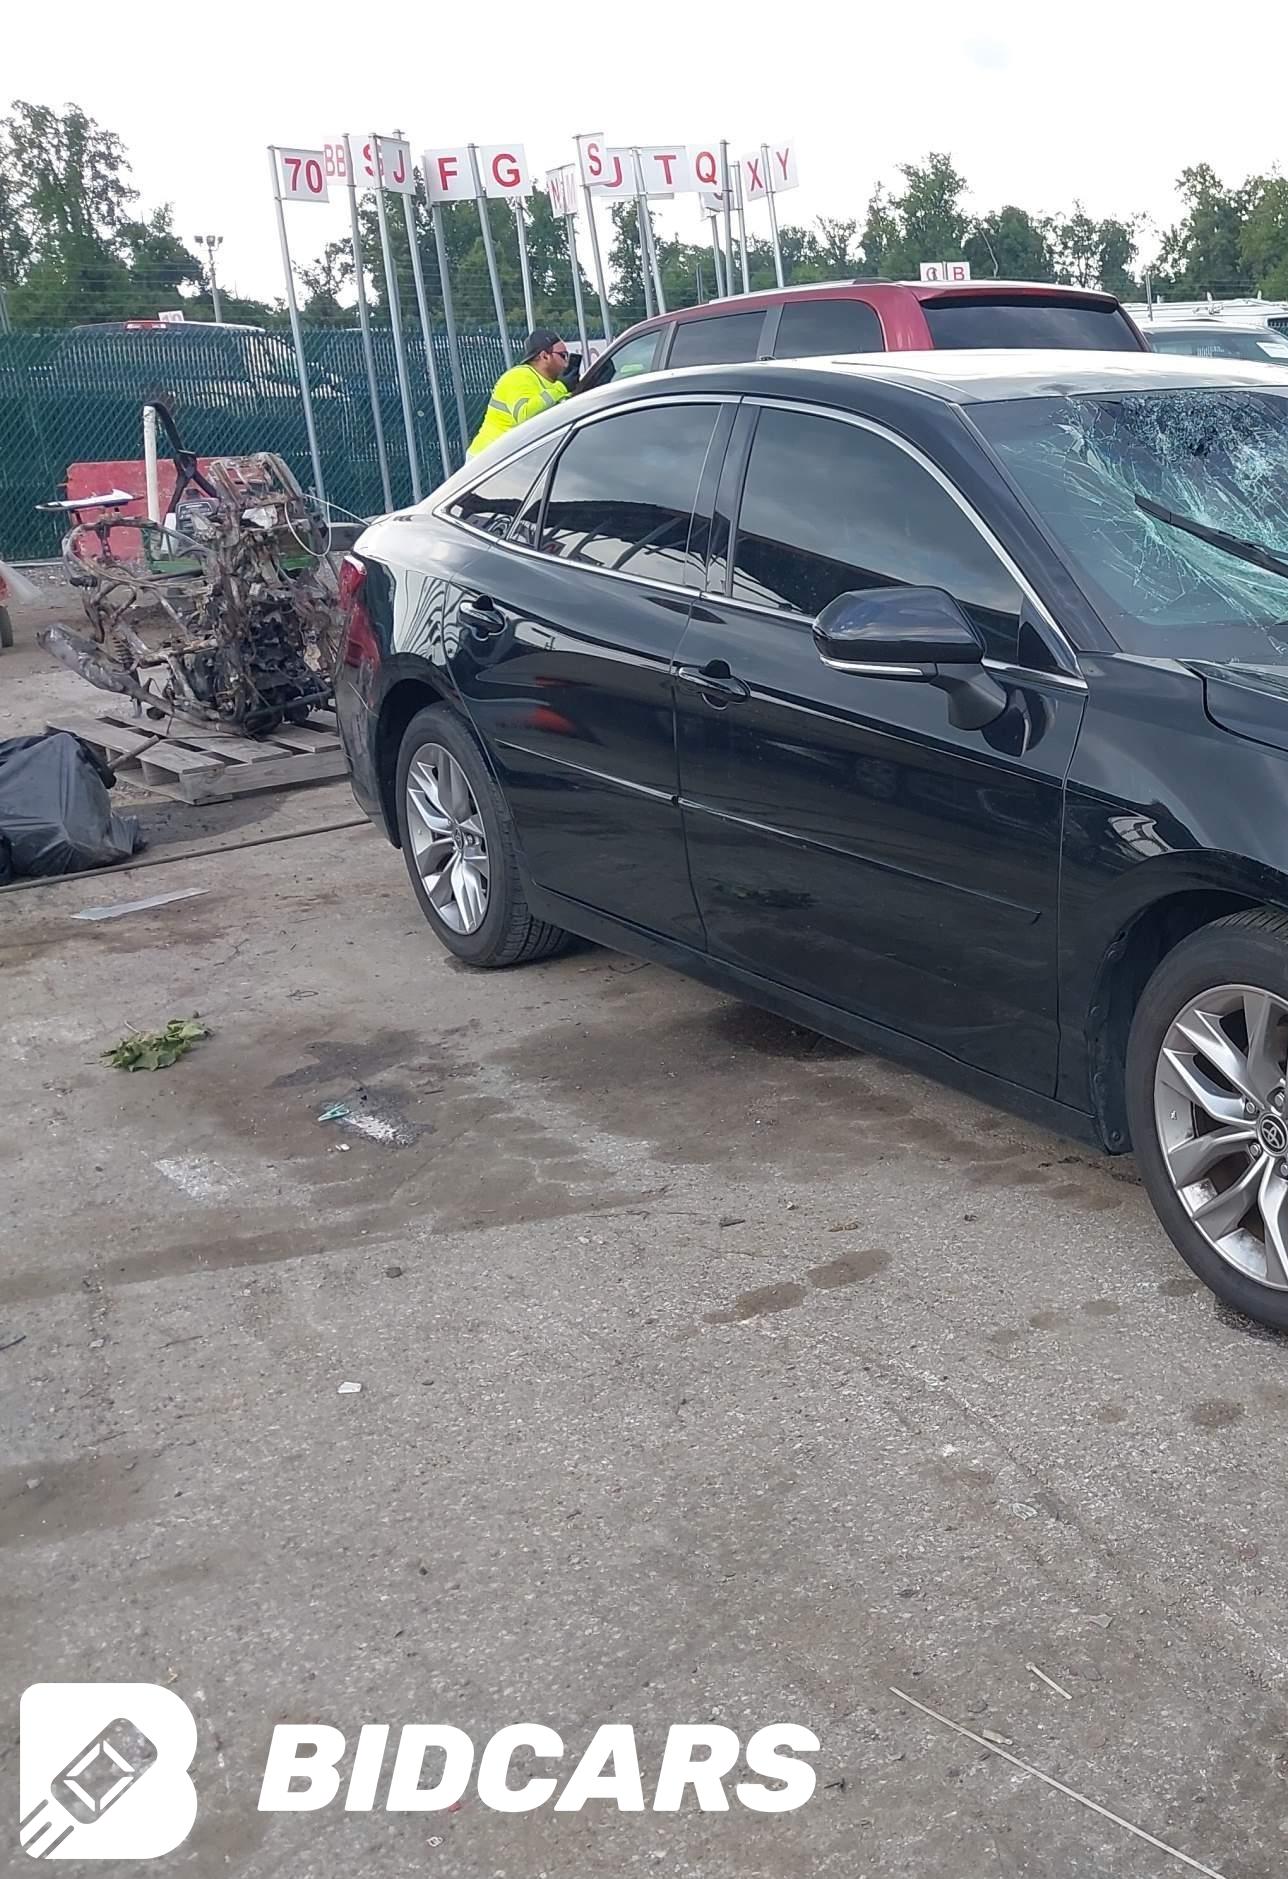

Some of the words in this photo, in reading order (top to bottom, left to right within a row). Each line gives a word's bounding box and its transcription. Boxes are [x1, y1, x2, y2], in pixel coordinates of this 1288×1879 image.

[285, 158, 323, 193] 70
[324, 144, 346, 177] BB
[393, 149, 405, 183] J
[438, 157, 457, 190] F
[492, 153, 520, 187] G
[588, 143, 602, 176] S
[604, 156, 622, 188] J
[653, 154, 677, 185] T
[695, 151, 717, 185] Q
[747, 158, 763, 192] X
[776, 147, 789, 181] Y
[952, 266, 965, 281] B
